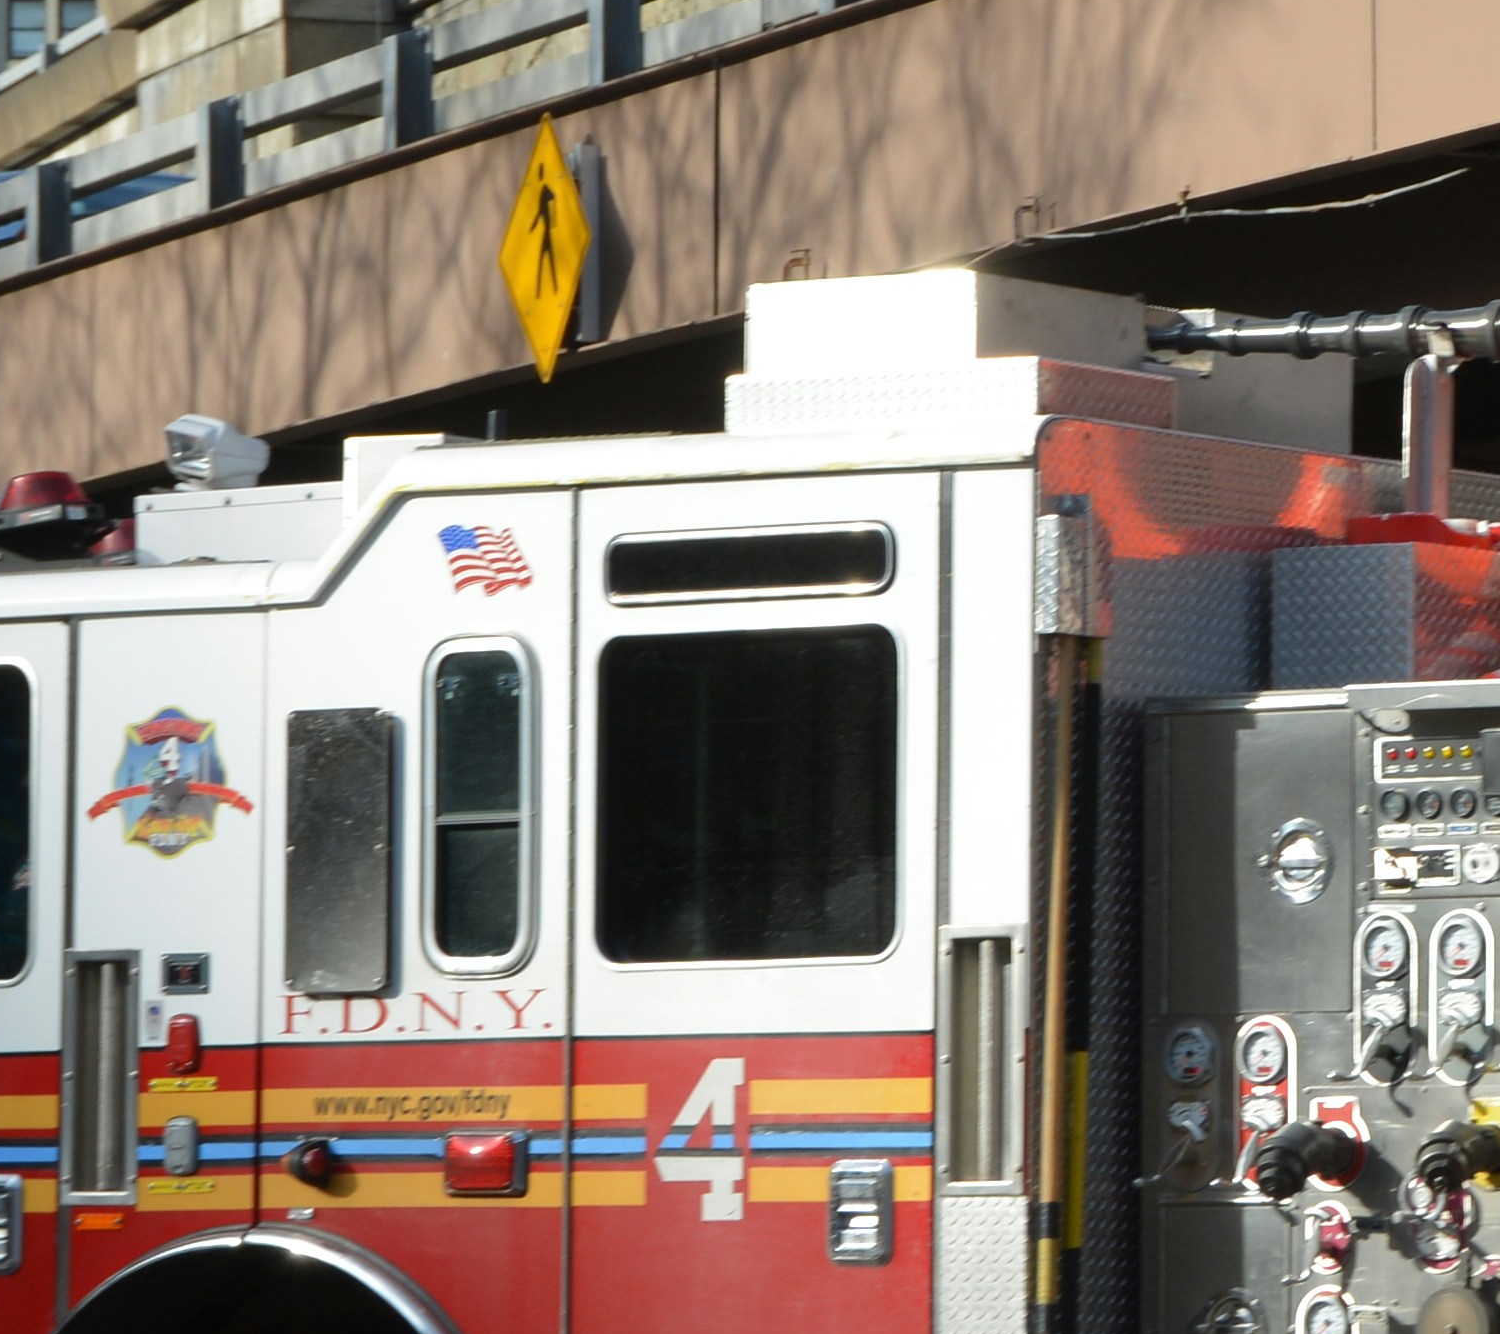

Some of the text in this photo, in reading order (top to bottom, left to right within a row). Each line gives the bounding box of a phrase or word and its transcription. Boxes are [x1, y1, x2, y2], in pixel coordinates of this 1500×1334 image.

[160, 736, 181, 773] 4
[276, 988, 553, 1035] F.D.N.Y.
[314, 1088, 511, 1119] www.nyc.gov/fdny
[654, 1057, 746, 1222] 4
